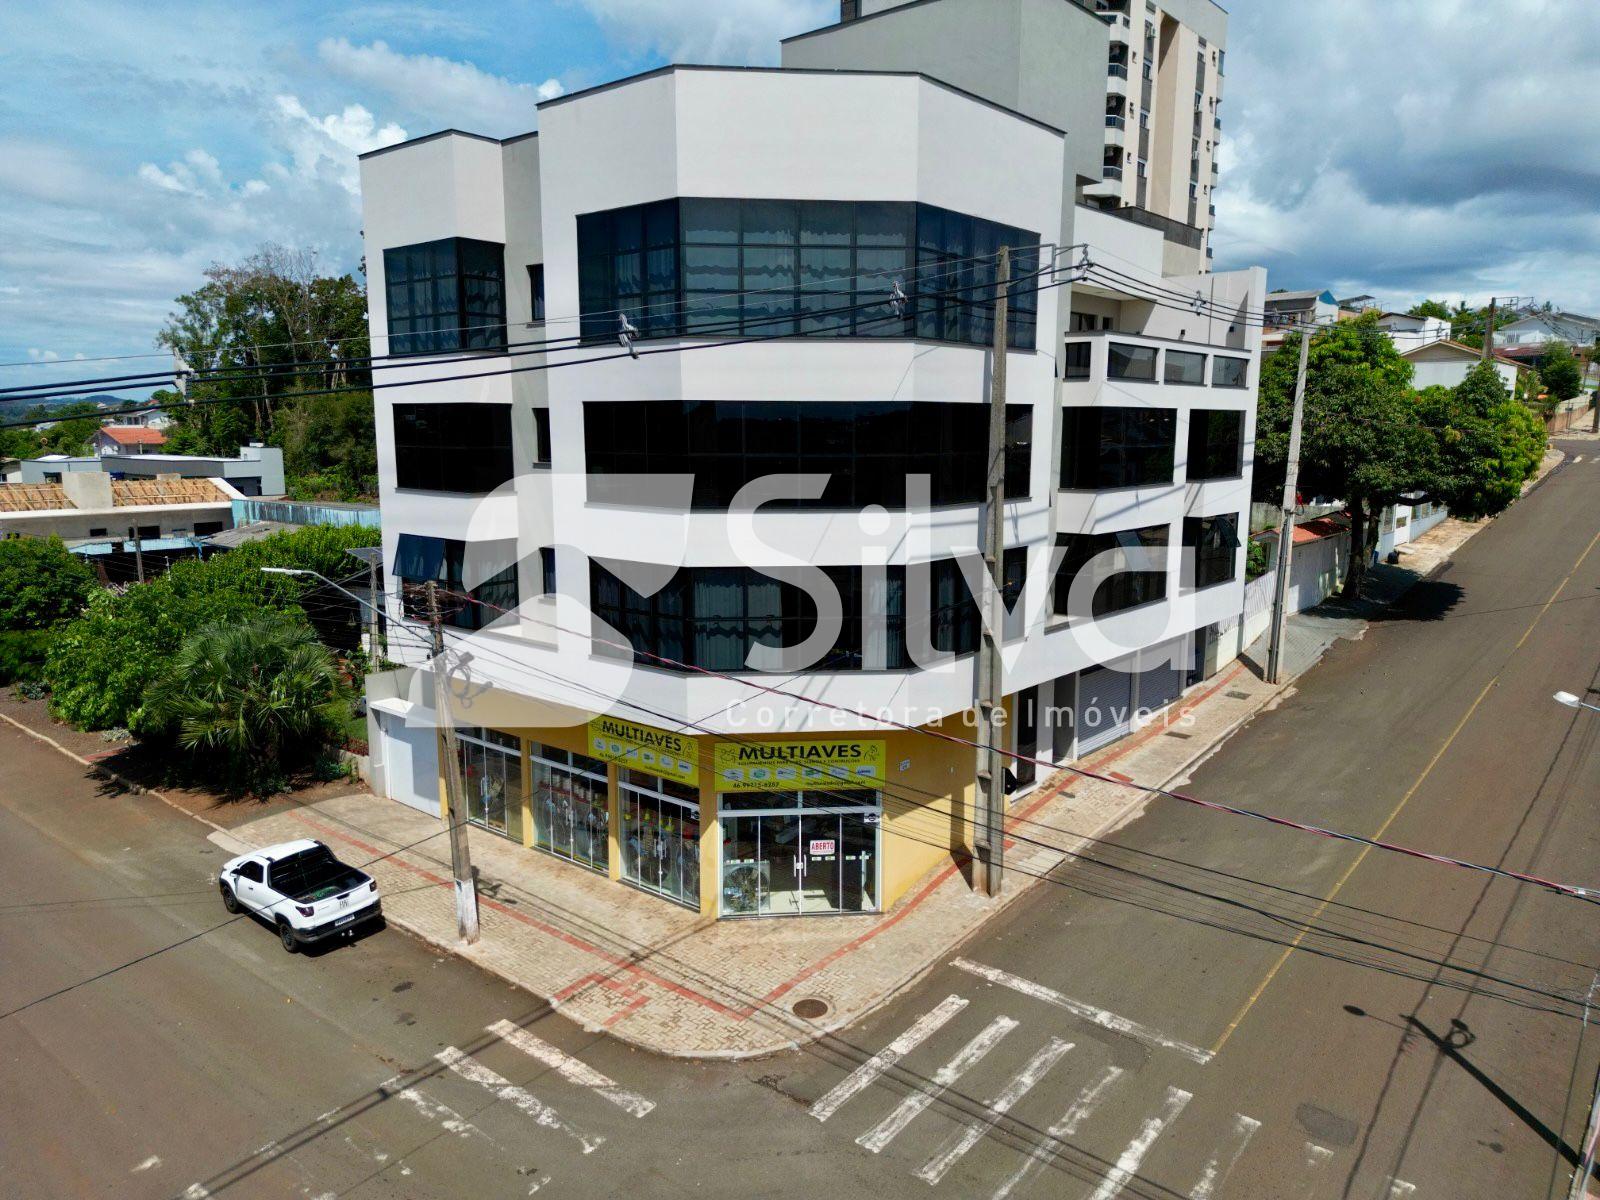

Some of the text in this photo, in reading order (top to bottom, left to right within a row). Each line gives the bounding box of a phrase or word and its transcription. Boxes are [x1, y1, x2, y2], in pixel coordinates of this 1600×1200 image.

[602, 720, 681, 752] MULTIAVES
[738, 744, 862, 761] MULTIAVES
[811, 842, 834, 850] ABERTO
